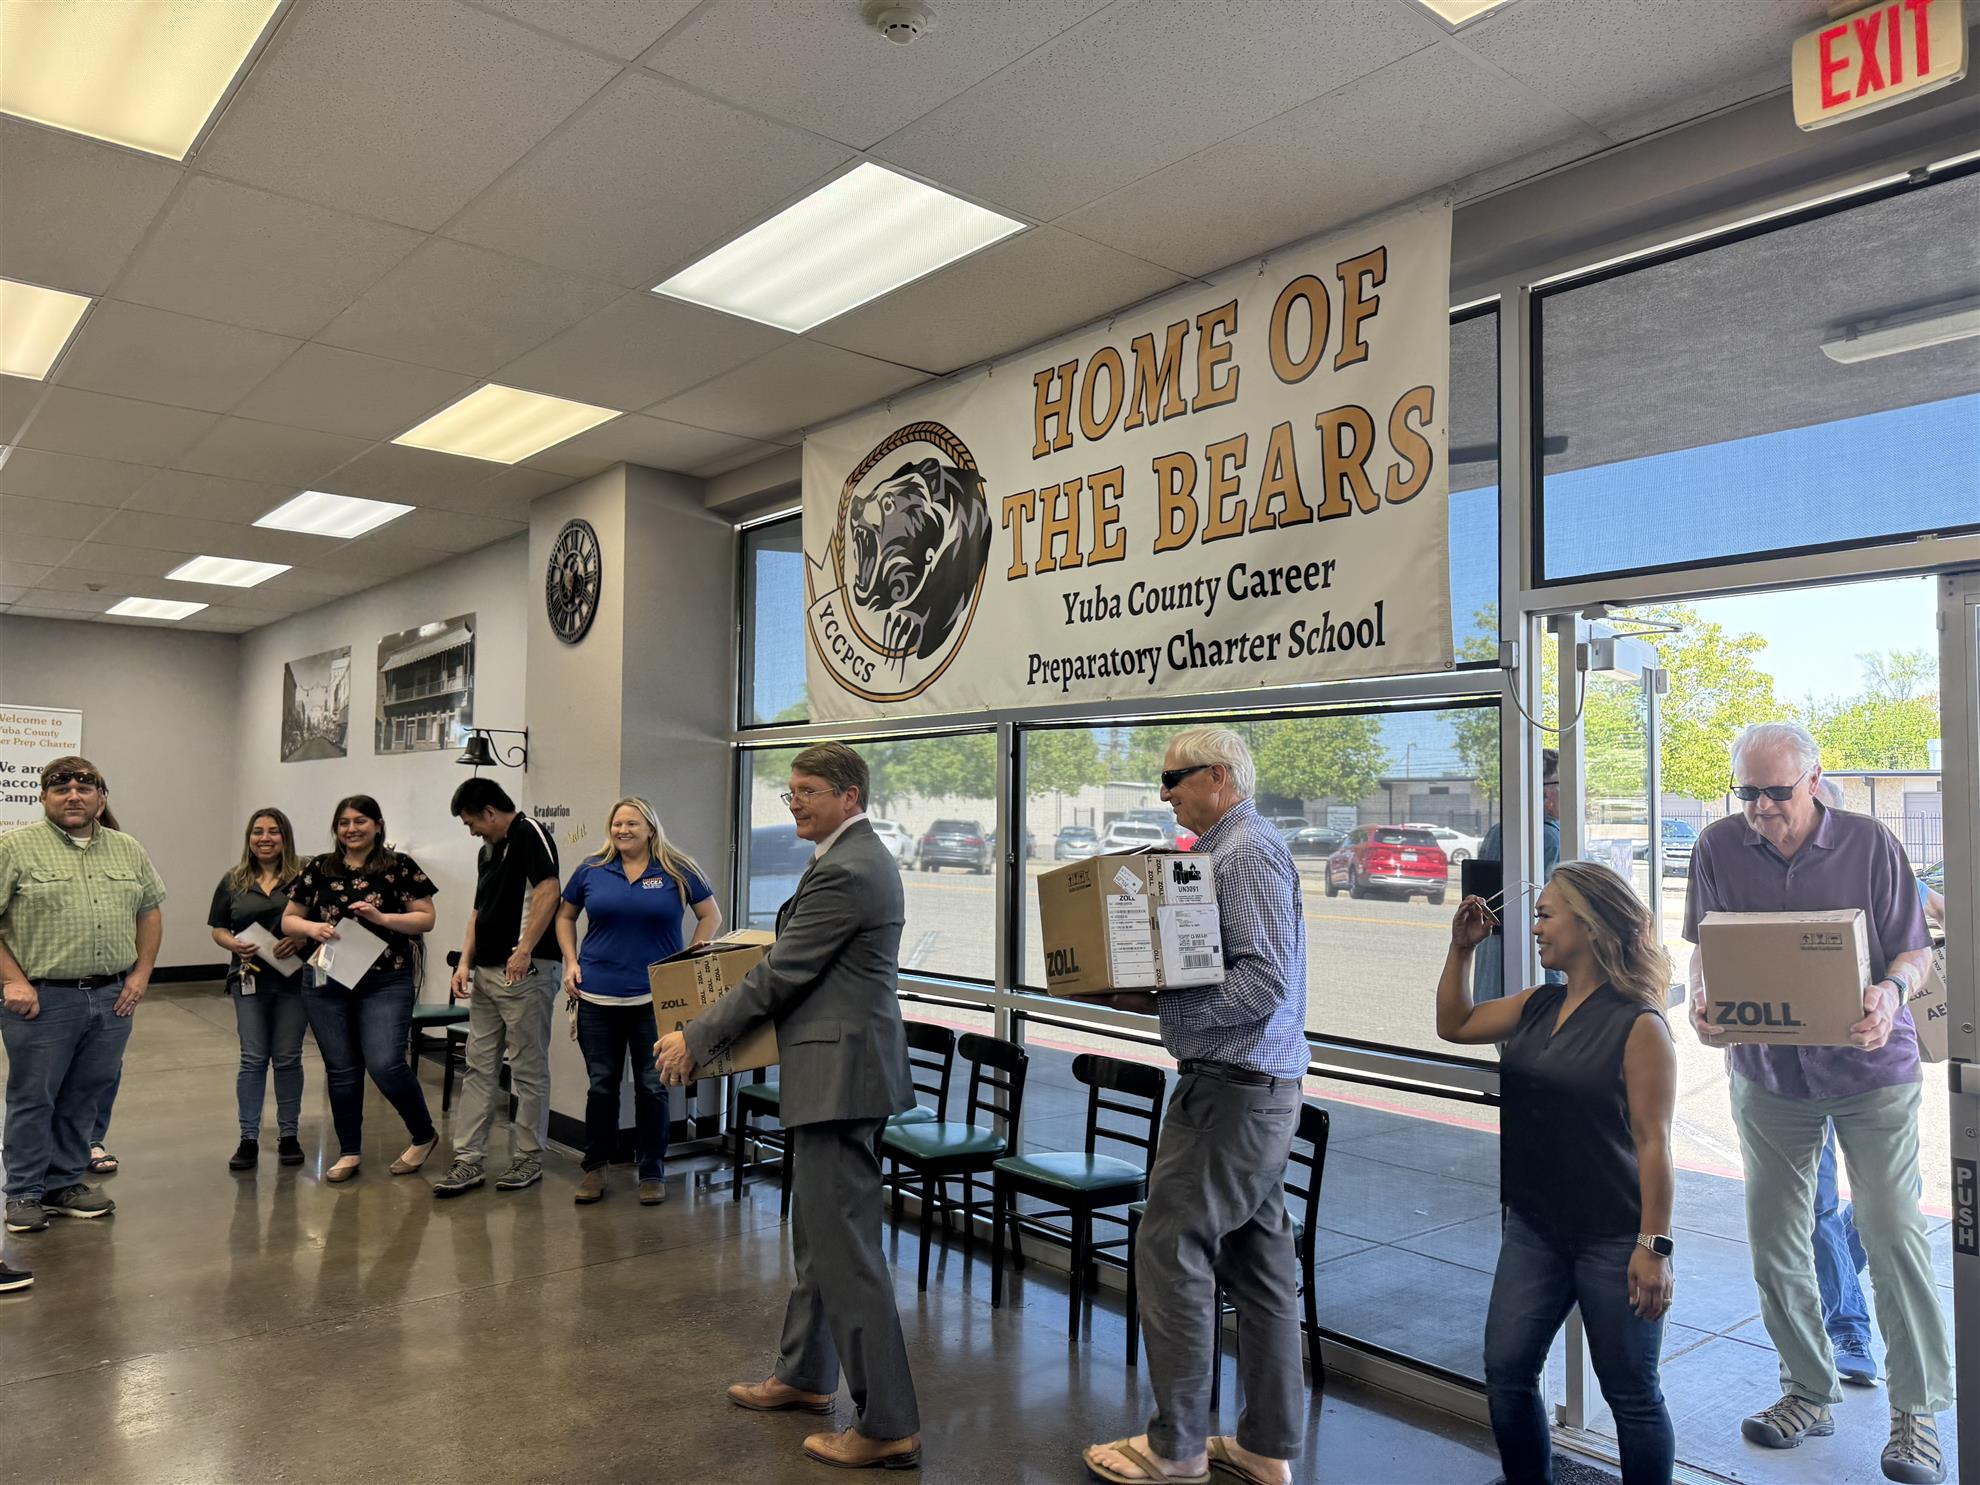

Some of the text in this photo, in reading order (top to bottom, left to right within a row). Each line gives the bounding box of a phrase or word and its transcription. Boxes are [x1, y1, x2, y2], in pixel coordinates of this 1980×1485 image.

[1818, 0, 1934, 110] EXIT
[1032, 245, 1387, 460] HOME OF
[1002, 385, 1436, 581] THE BEARS
[1062, 558, 1336, 626] Yuba County Career
[819, 601, 876, 683] YCCPCS
[1026, 599, 1386, 693] Preparatory Charter School
[23, 727, 60, 739] County
[51, 718, 63, 727] to
[13, 737, 36, 748] Prep
[39, 739, 77, 749] Charter
[21, 765, 44, 775] are
[0, 779, 41, 789] acco-
[0, 790, 42, 806] amp
[533, 804, 570, 818] Graduation
[1046, 947, 1080, 977] ZOLL
[661, 998, 689, 1010] ZOLL
[1715, 1001, 1802, 1026] ZOLL
[1956, 1166, 1975, 1248] PUSH
